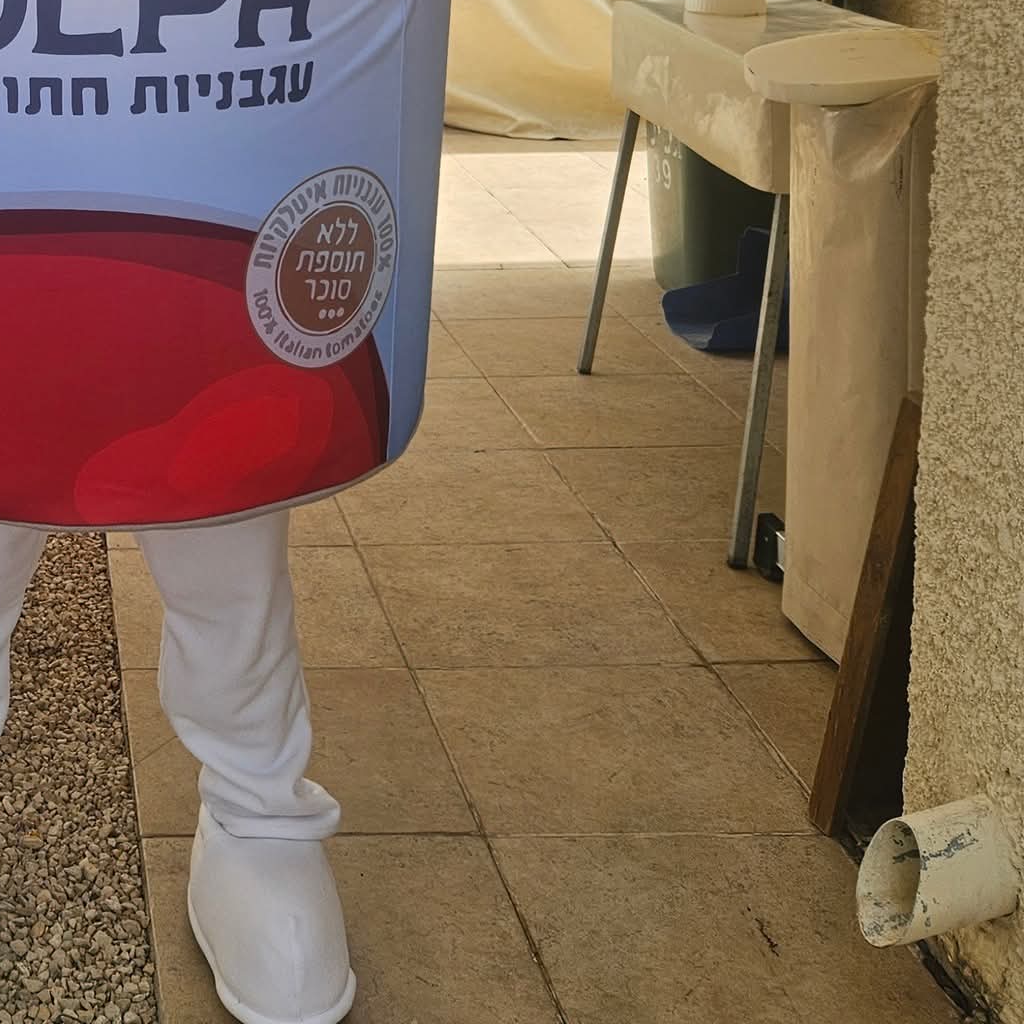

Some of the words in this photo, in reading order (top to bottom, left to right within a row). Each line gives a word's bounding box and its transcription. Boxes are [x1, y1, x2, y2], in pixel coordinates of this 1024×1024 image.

[130, 60, 313, 116] עגבניות
[316, 217, 359, 245] ללא
[295, 250, 365, 273] תוספת
[304, 279, 351, 301] סוכר
[273, 330, 322, 359] Italian
